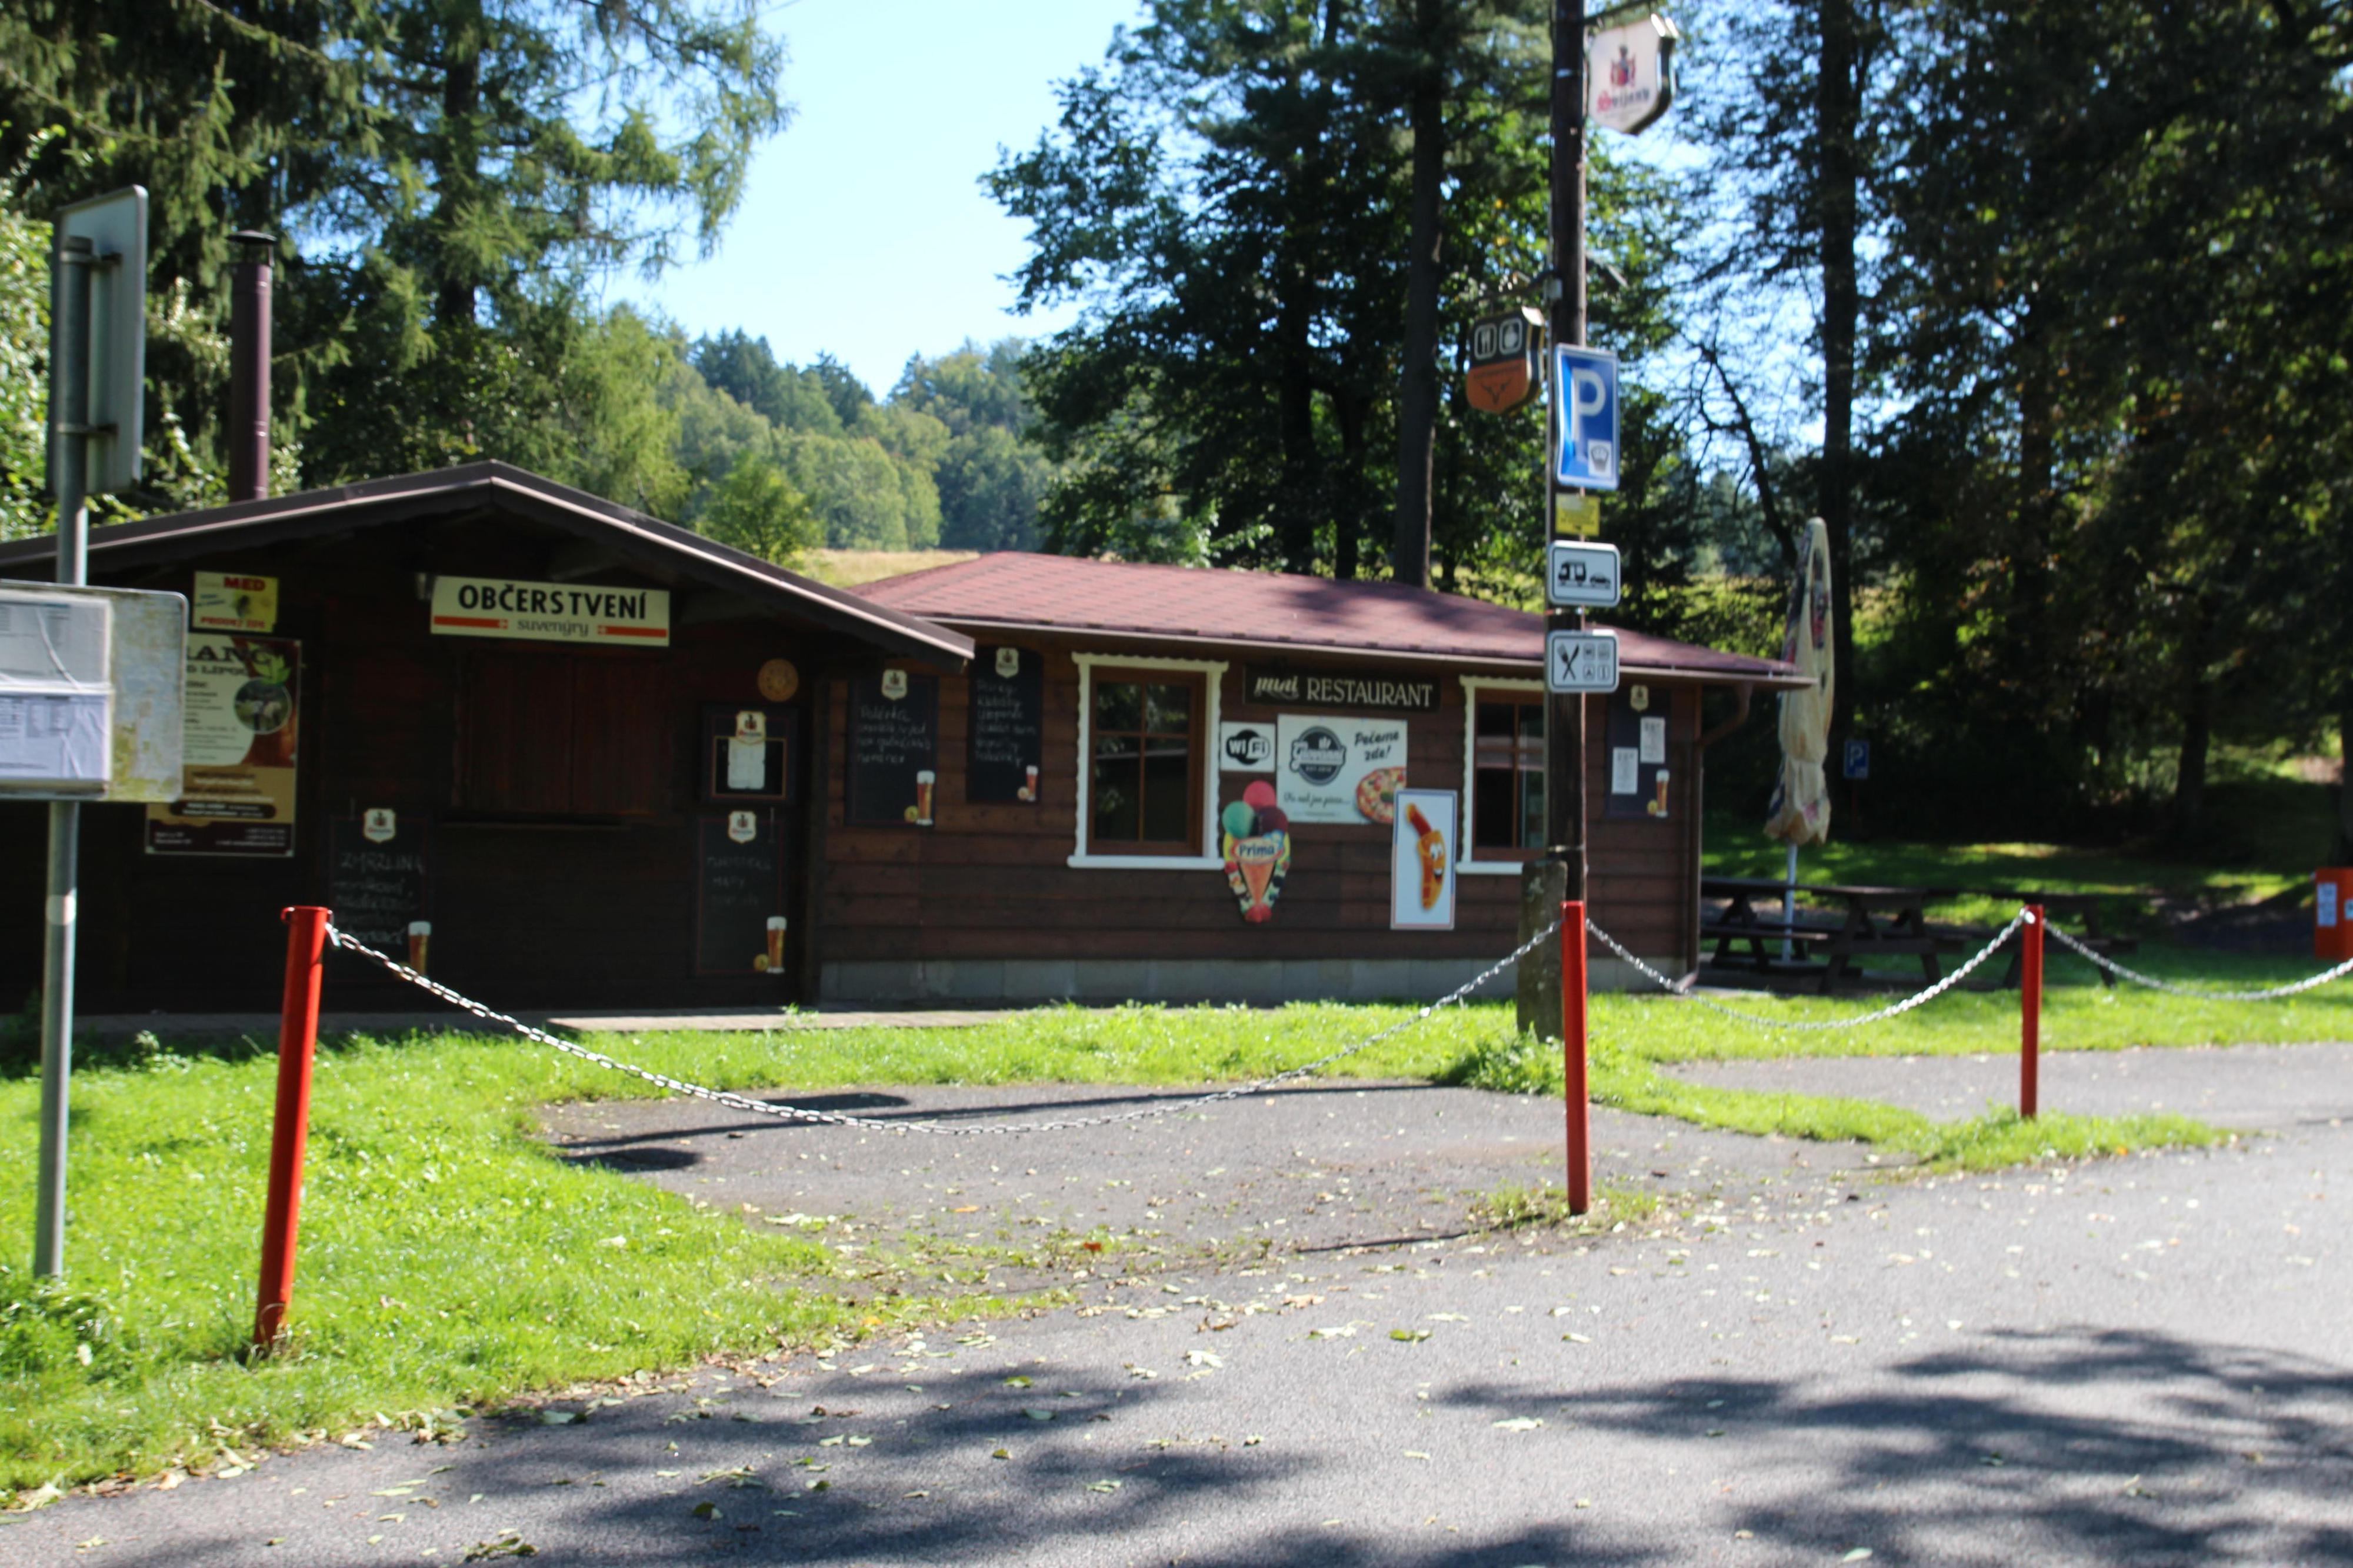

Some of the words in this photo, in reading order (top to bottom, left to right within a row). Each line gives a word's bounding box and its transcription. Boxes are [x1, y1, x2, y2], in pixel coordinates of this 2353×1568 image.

[1573, 368, 1607, 441] P
[224, 577, 266, 592] MED
[458, 583, 647, 620] OBČERSTVENÍ
[516, 618, 589, 637] suvenýry
[1306, 677, 1433, 708] RESTAURANT
[1354, 730, 1399, 747] Pečeme
[1364, 745, 1391, 762] zde!
[1849, 745, 1864, 768] P
[1239, 842, 1275, 856] Prima
